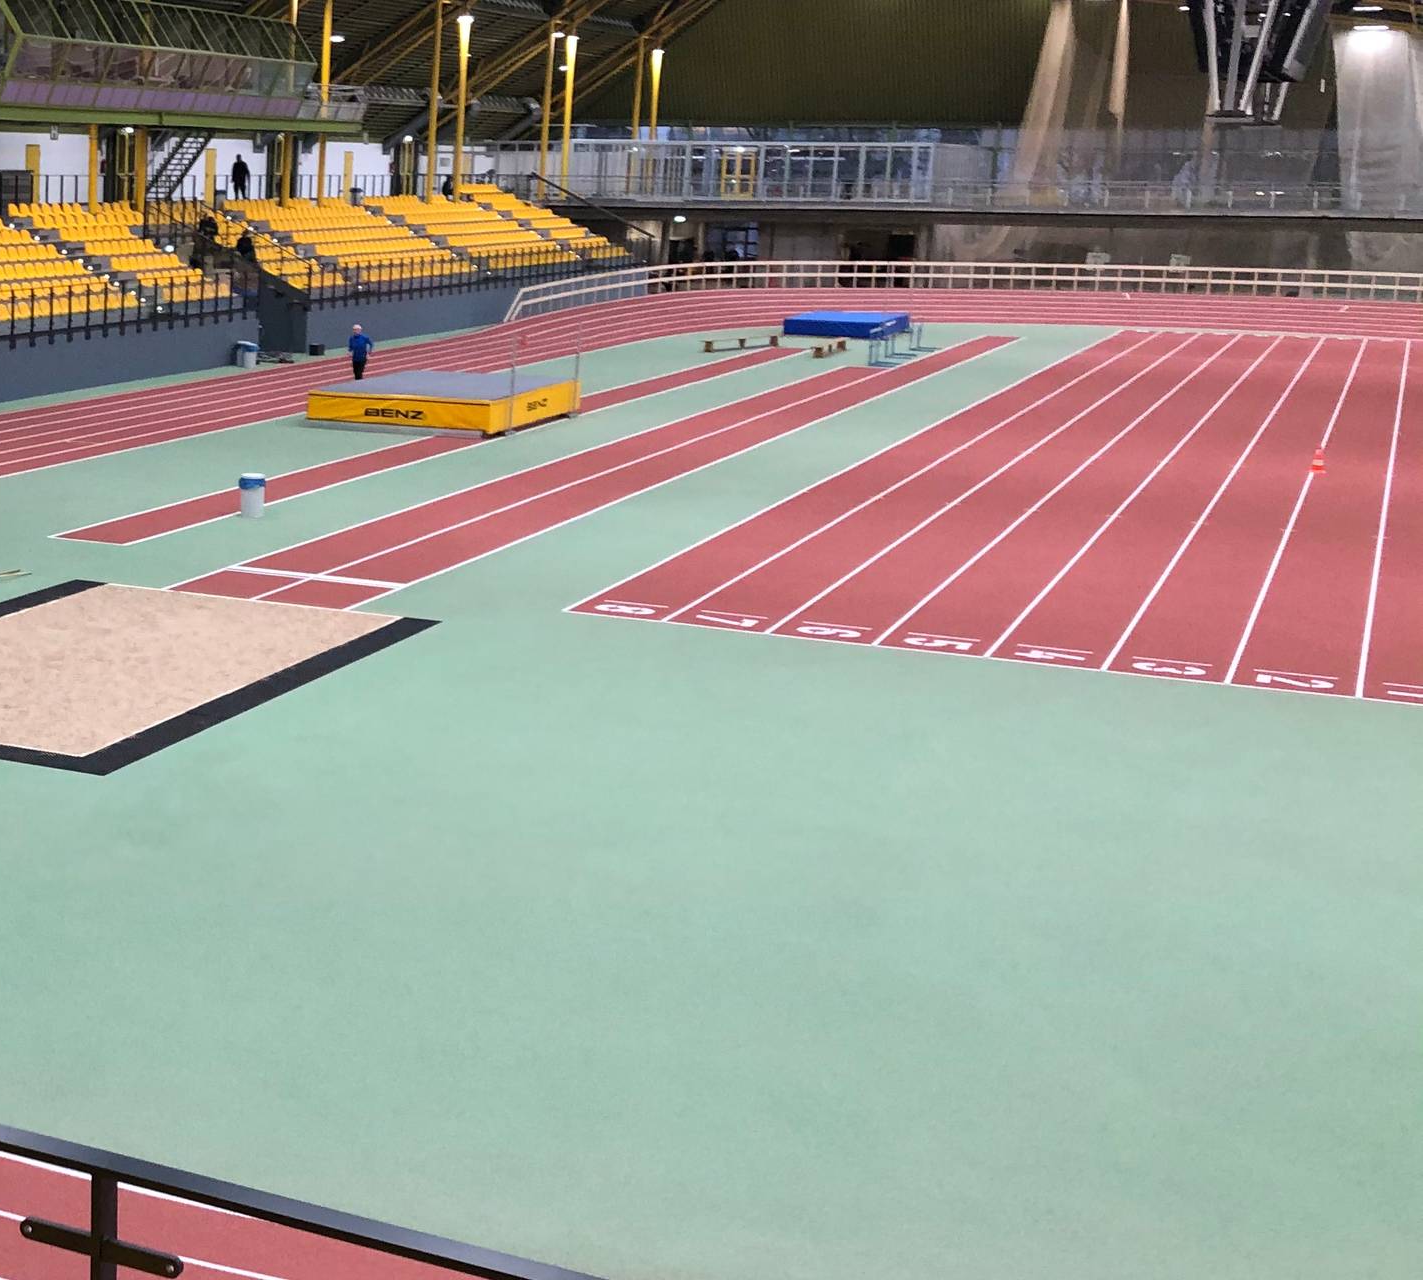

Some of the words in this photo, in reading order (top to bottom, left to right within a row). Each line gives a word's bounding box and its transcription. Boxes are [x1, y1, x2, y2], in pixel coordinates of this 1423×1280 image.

[364, 407, 424, 420] BENZ
[594, 604, 656, 615] 8
[695, 615, 760, 628] 7
[796, 626, 862, 638] 6
[903, 637, 974, 650] 5
[1014, 650, 1086, 661] 4
[1132, 662, 1207, 676] 3
[1255, 673, 1335, 689] 2
